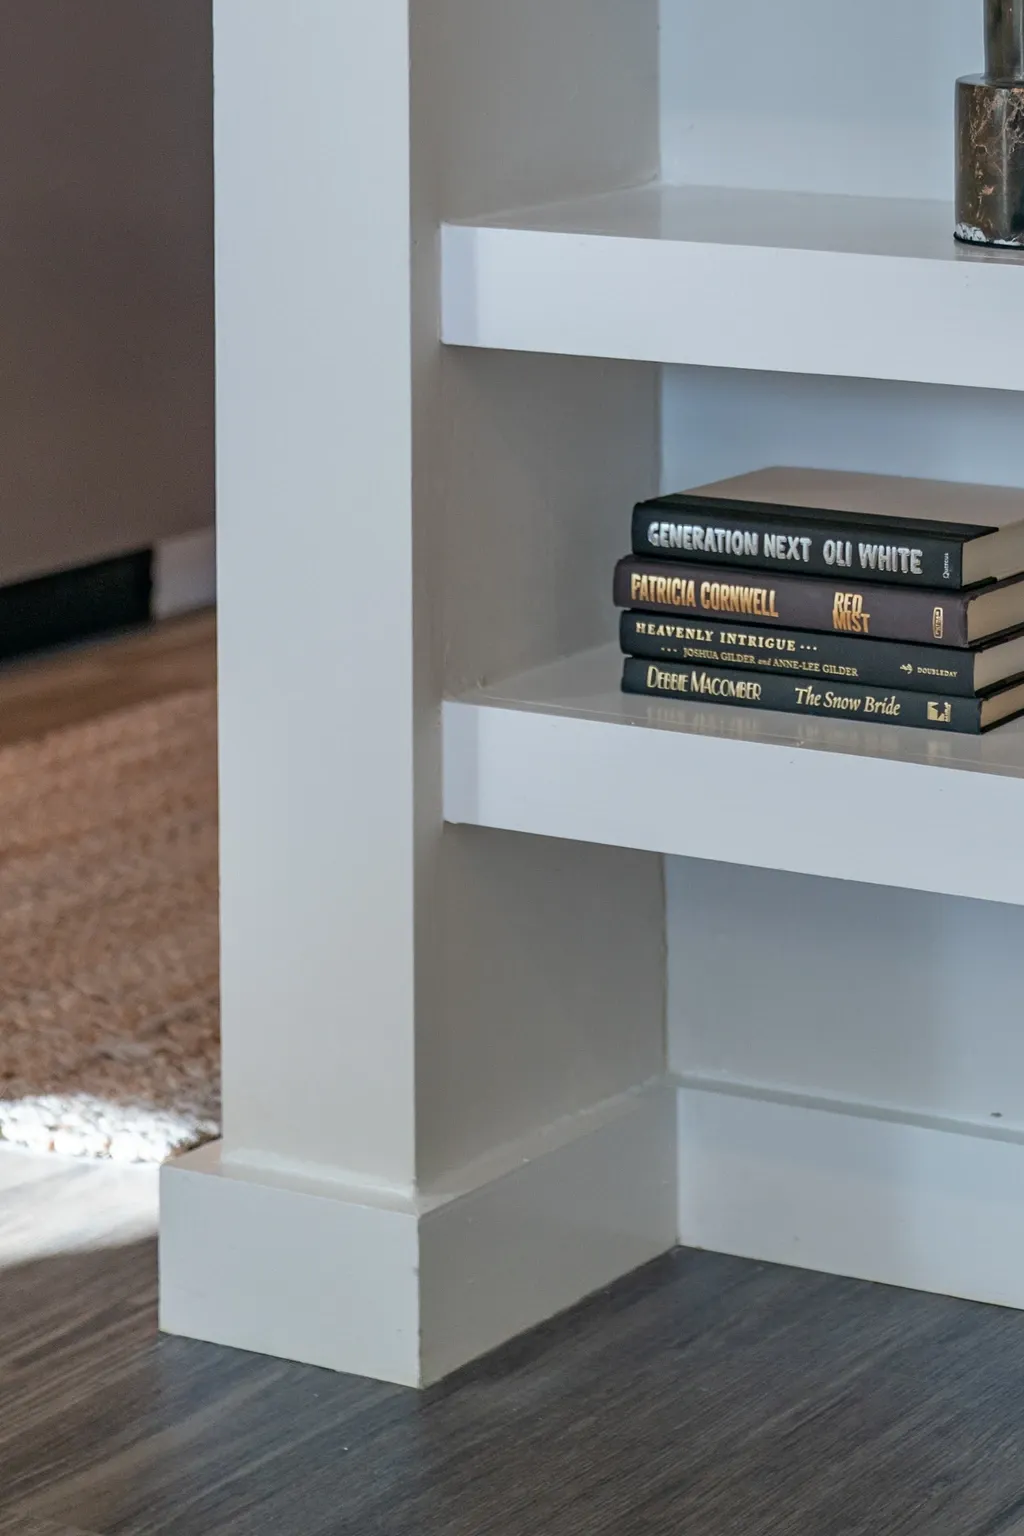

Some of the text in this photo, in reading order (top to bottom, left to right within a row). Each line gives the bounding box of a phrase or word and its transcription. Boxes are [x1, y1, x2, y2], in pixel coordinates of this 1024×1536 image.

[647, 521, 923, 575] GENERATION NEXT OLI WHITE
[942, 552, 950, 579] Quercus
[630, 573, 779, 618] PATRICIA CORNWELL
[834, 591, 863, 614] RED
[832, 608, 871, 634] MIST
[635, 622, 796, 652] HEAVENLY INTRIGUE
[683, 647, 859, 677] JOSHUA GILDER and ANNE-LEE GILDER
[917, 666, 958, 678] DOUBLEDAY
[794, 685, 901, 716] The Snow Bride
